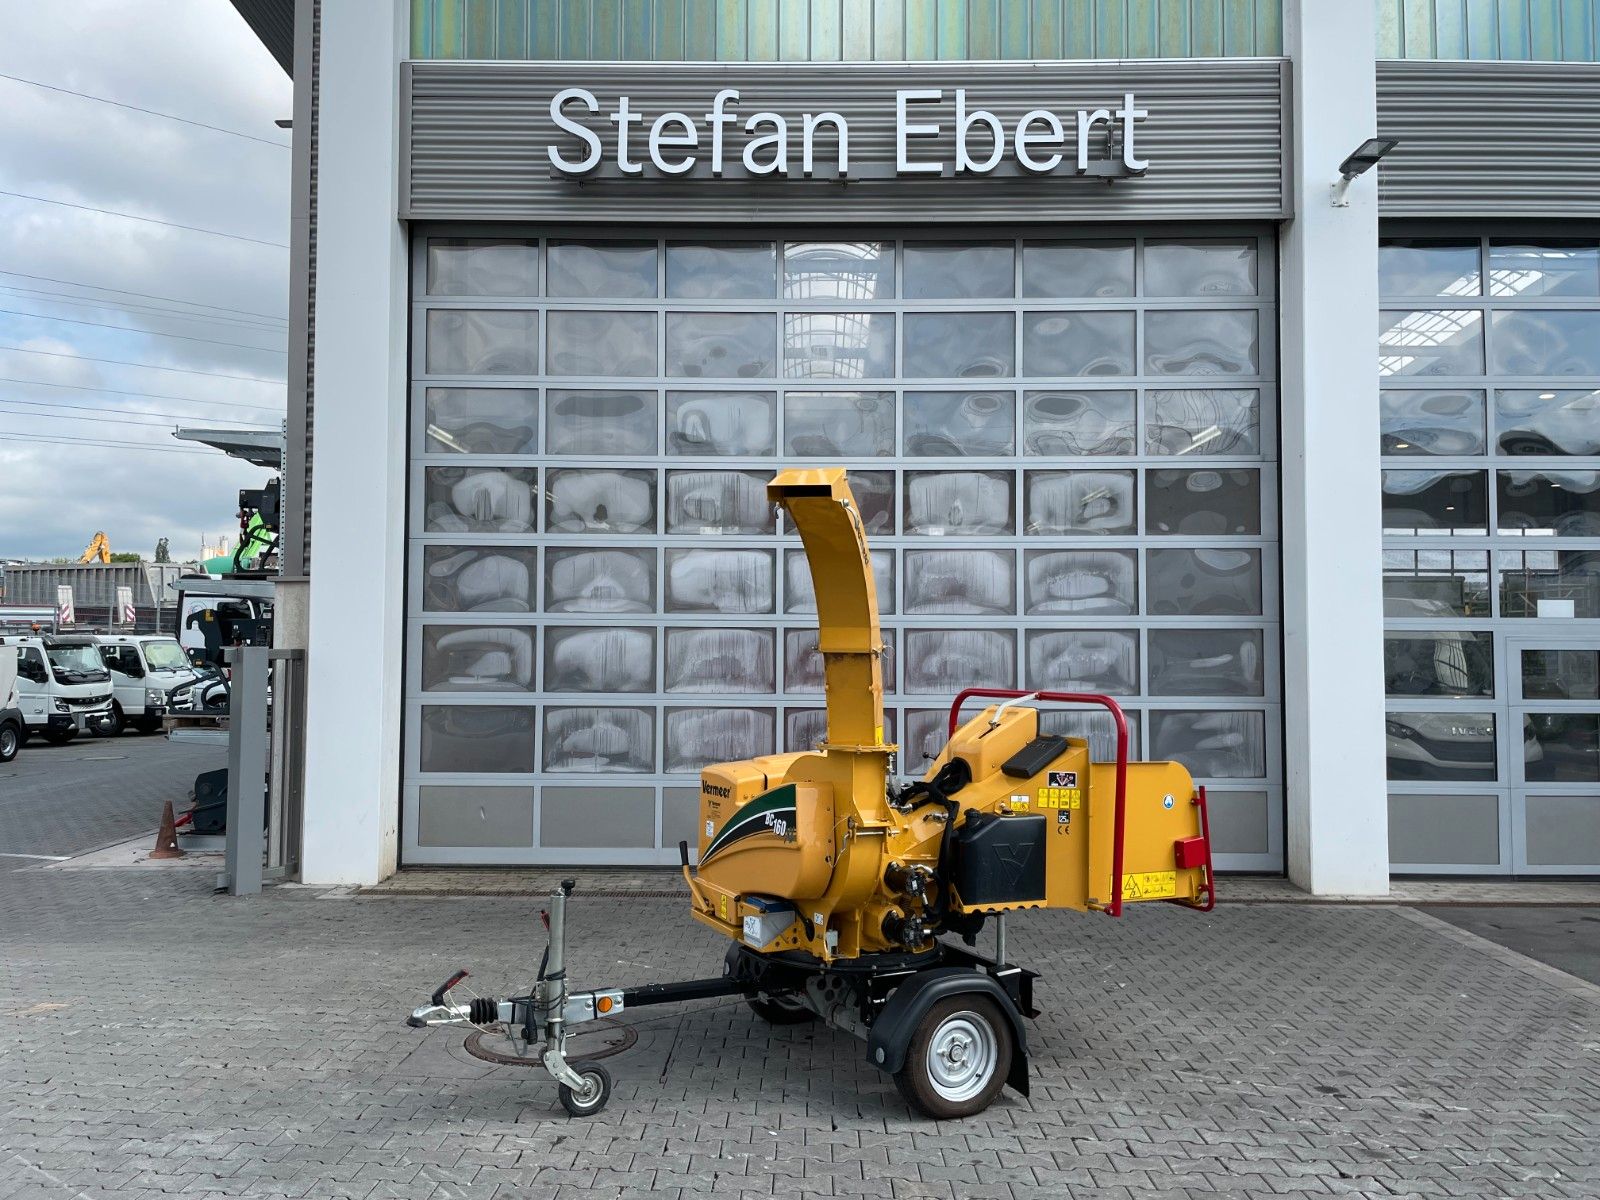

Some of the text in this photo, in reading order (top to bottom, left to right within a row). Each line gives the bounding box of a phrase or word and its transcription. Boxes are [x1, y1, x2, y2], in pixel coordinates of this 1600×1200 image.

[547, 88, 1149, 177] Stefan Ebert
[702, 779, 731, 798] Vermeer
